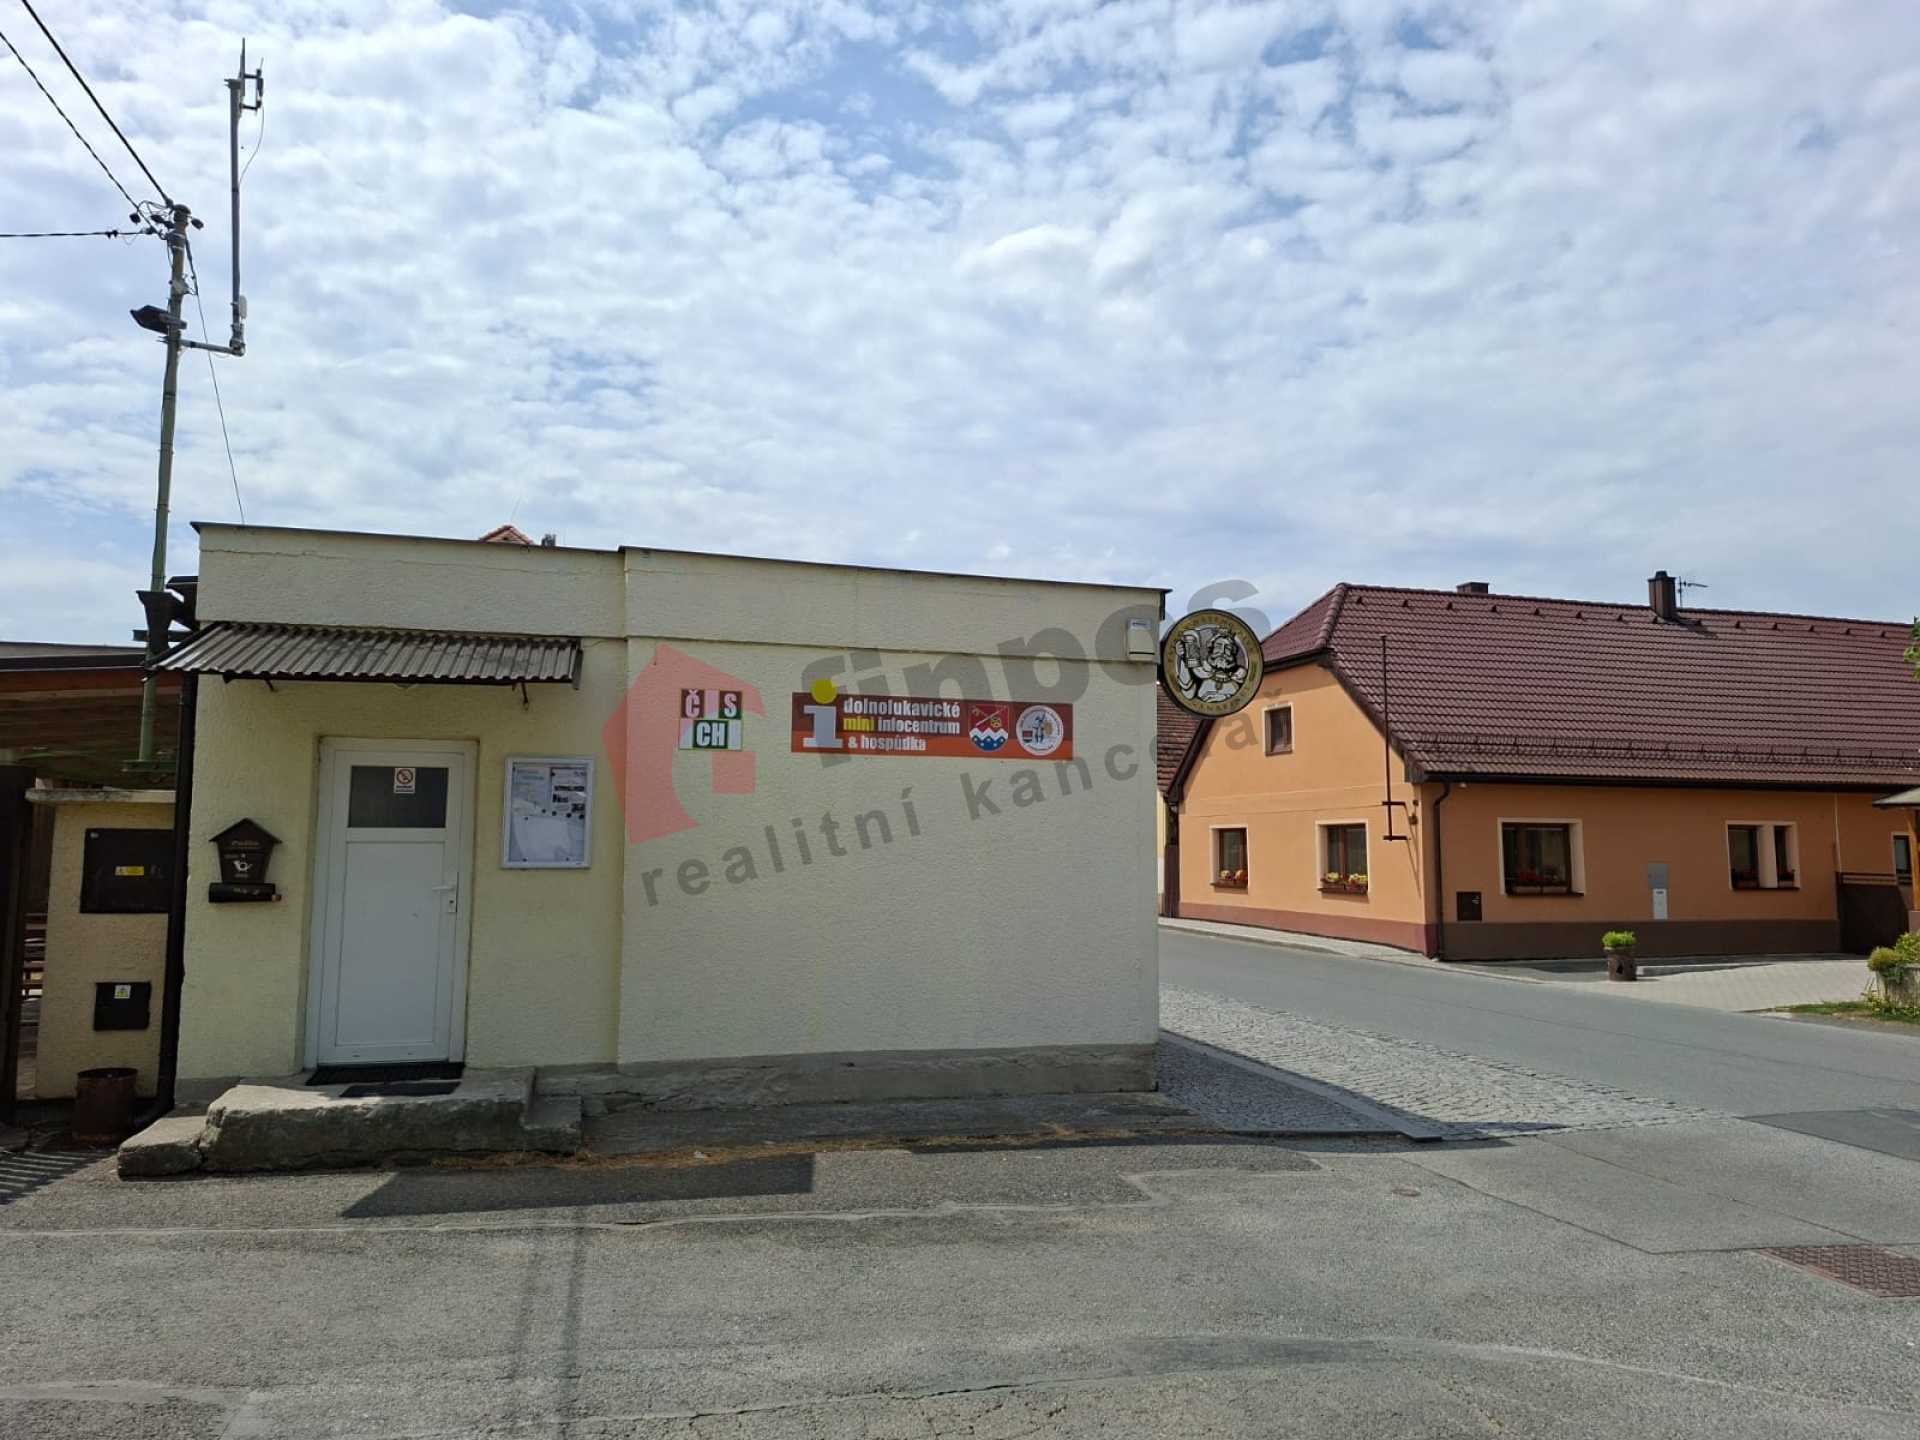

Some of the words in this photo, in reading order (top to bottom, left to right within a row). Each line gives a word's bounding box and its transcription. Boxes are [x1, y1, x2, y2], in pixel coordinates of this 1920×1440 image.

[843, 697, 960, 718] dolnolukavické
[843, 715, 875, 731] mini
[877, 716, 960, 734] infocentrum
[848, 736, 858, 749] &
[861, 734, 926, 751] hospůdka
